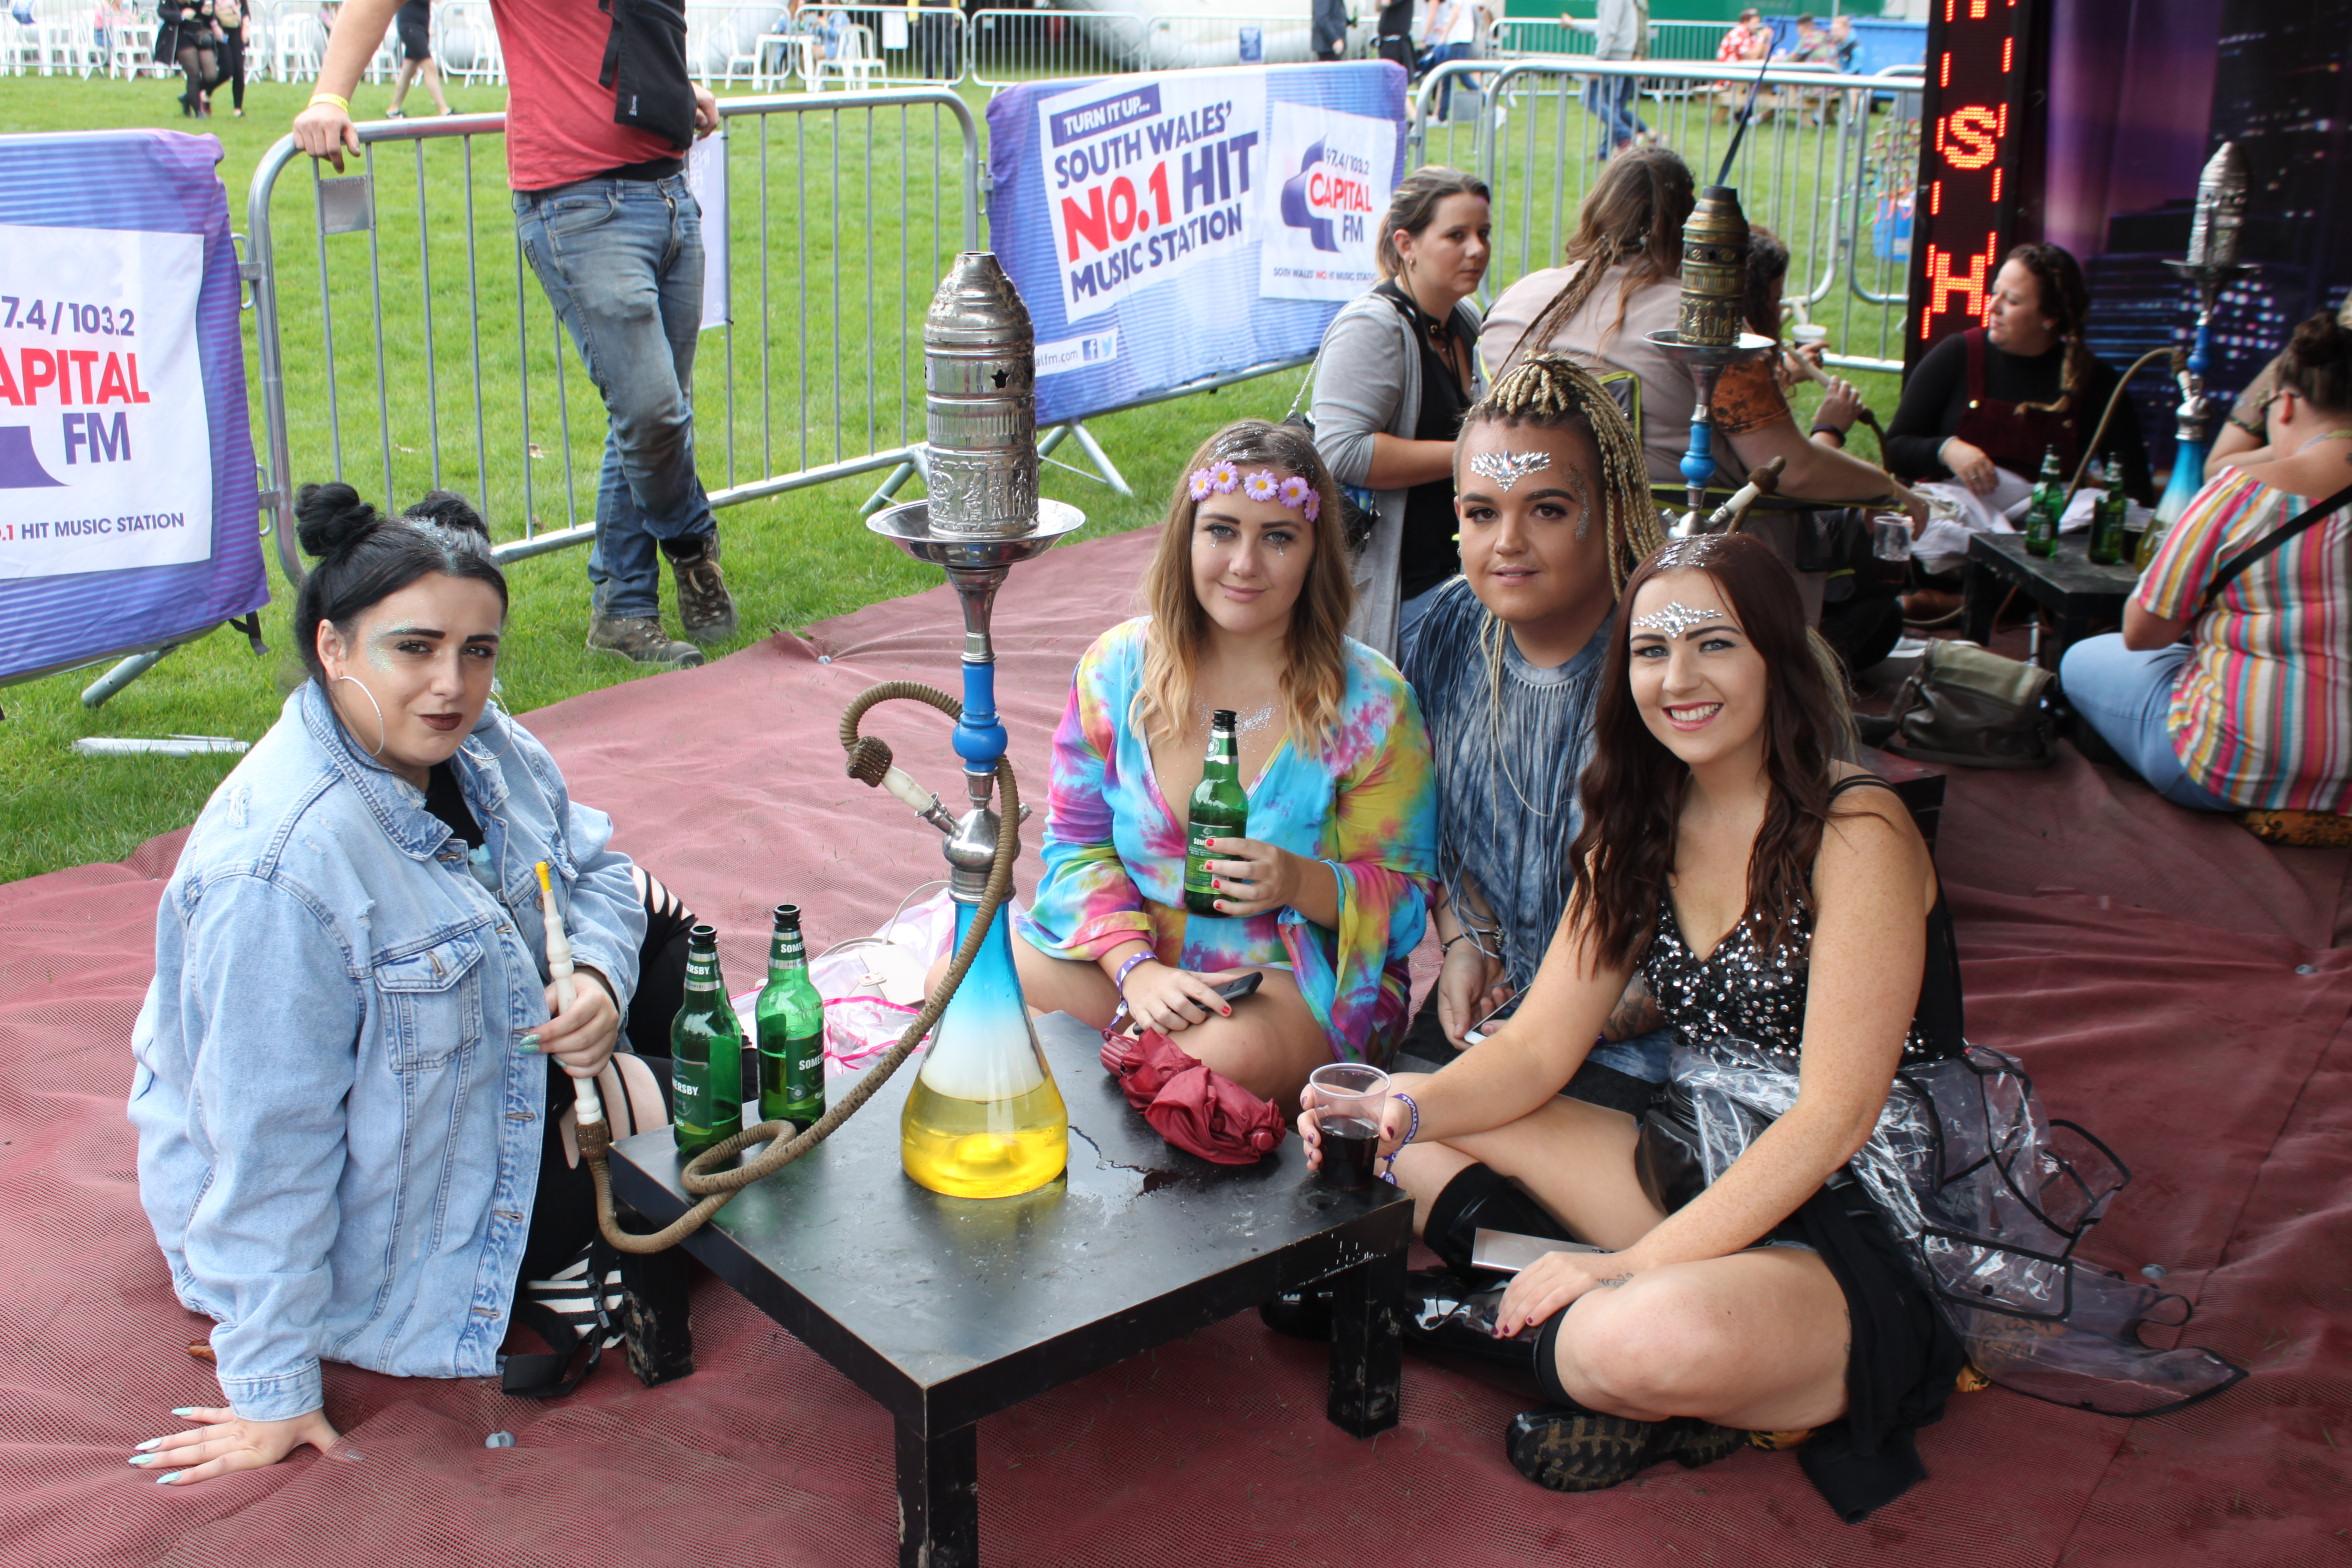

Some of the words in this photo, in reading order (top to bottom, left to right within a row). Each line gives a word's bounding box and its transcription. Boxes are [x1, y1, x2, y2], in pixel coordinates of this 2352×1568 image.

[1063, 106, 1106, 136] TURN
[1107, 101, 1121, 123] IT
[1121, 95, 1151, 118] UP...
[1054, 129, 1142, 190] SOUTH
[1147, 100, 1232, 155] WALES'
[1061, 160, 1172, 263] NO.1
[1182, 131, 1258, 215] HIT
[1309, 171, 1373, 212] CAPITAL
[1342, 213, 1364, 243] FM
[1070, 242, 1143, 303] MUSIC
[1149, 203, 1242, 268] STATION
[62, 411, 132, 465] FM
[21, 522, 50, 540] HIT
[55, 518, 112, 537] MUSIC
[117, 512, 185, 533] STATION
